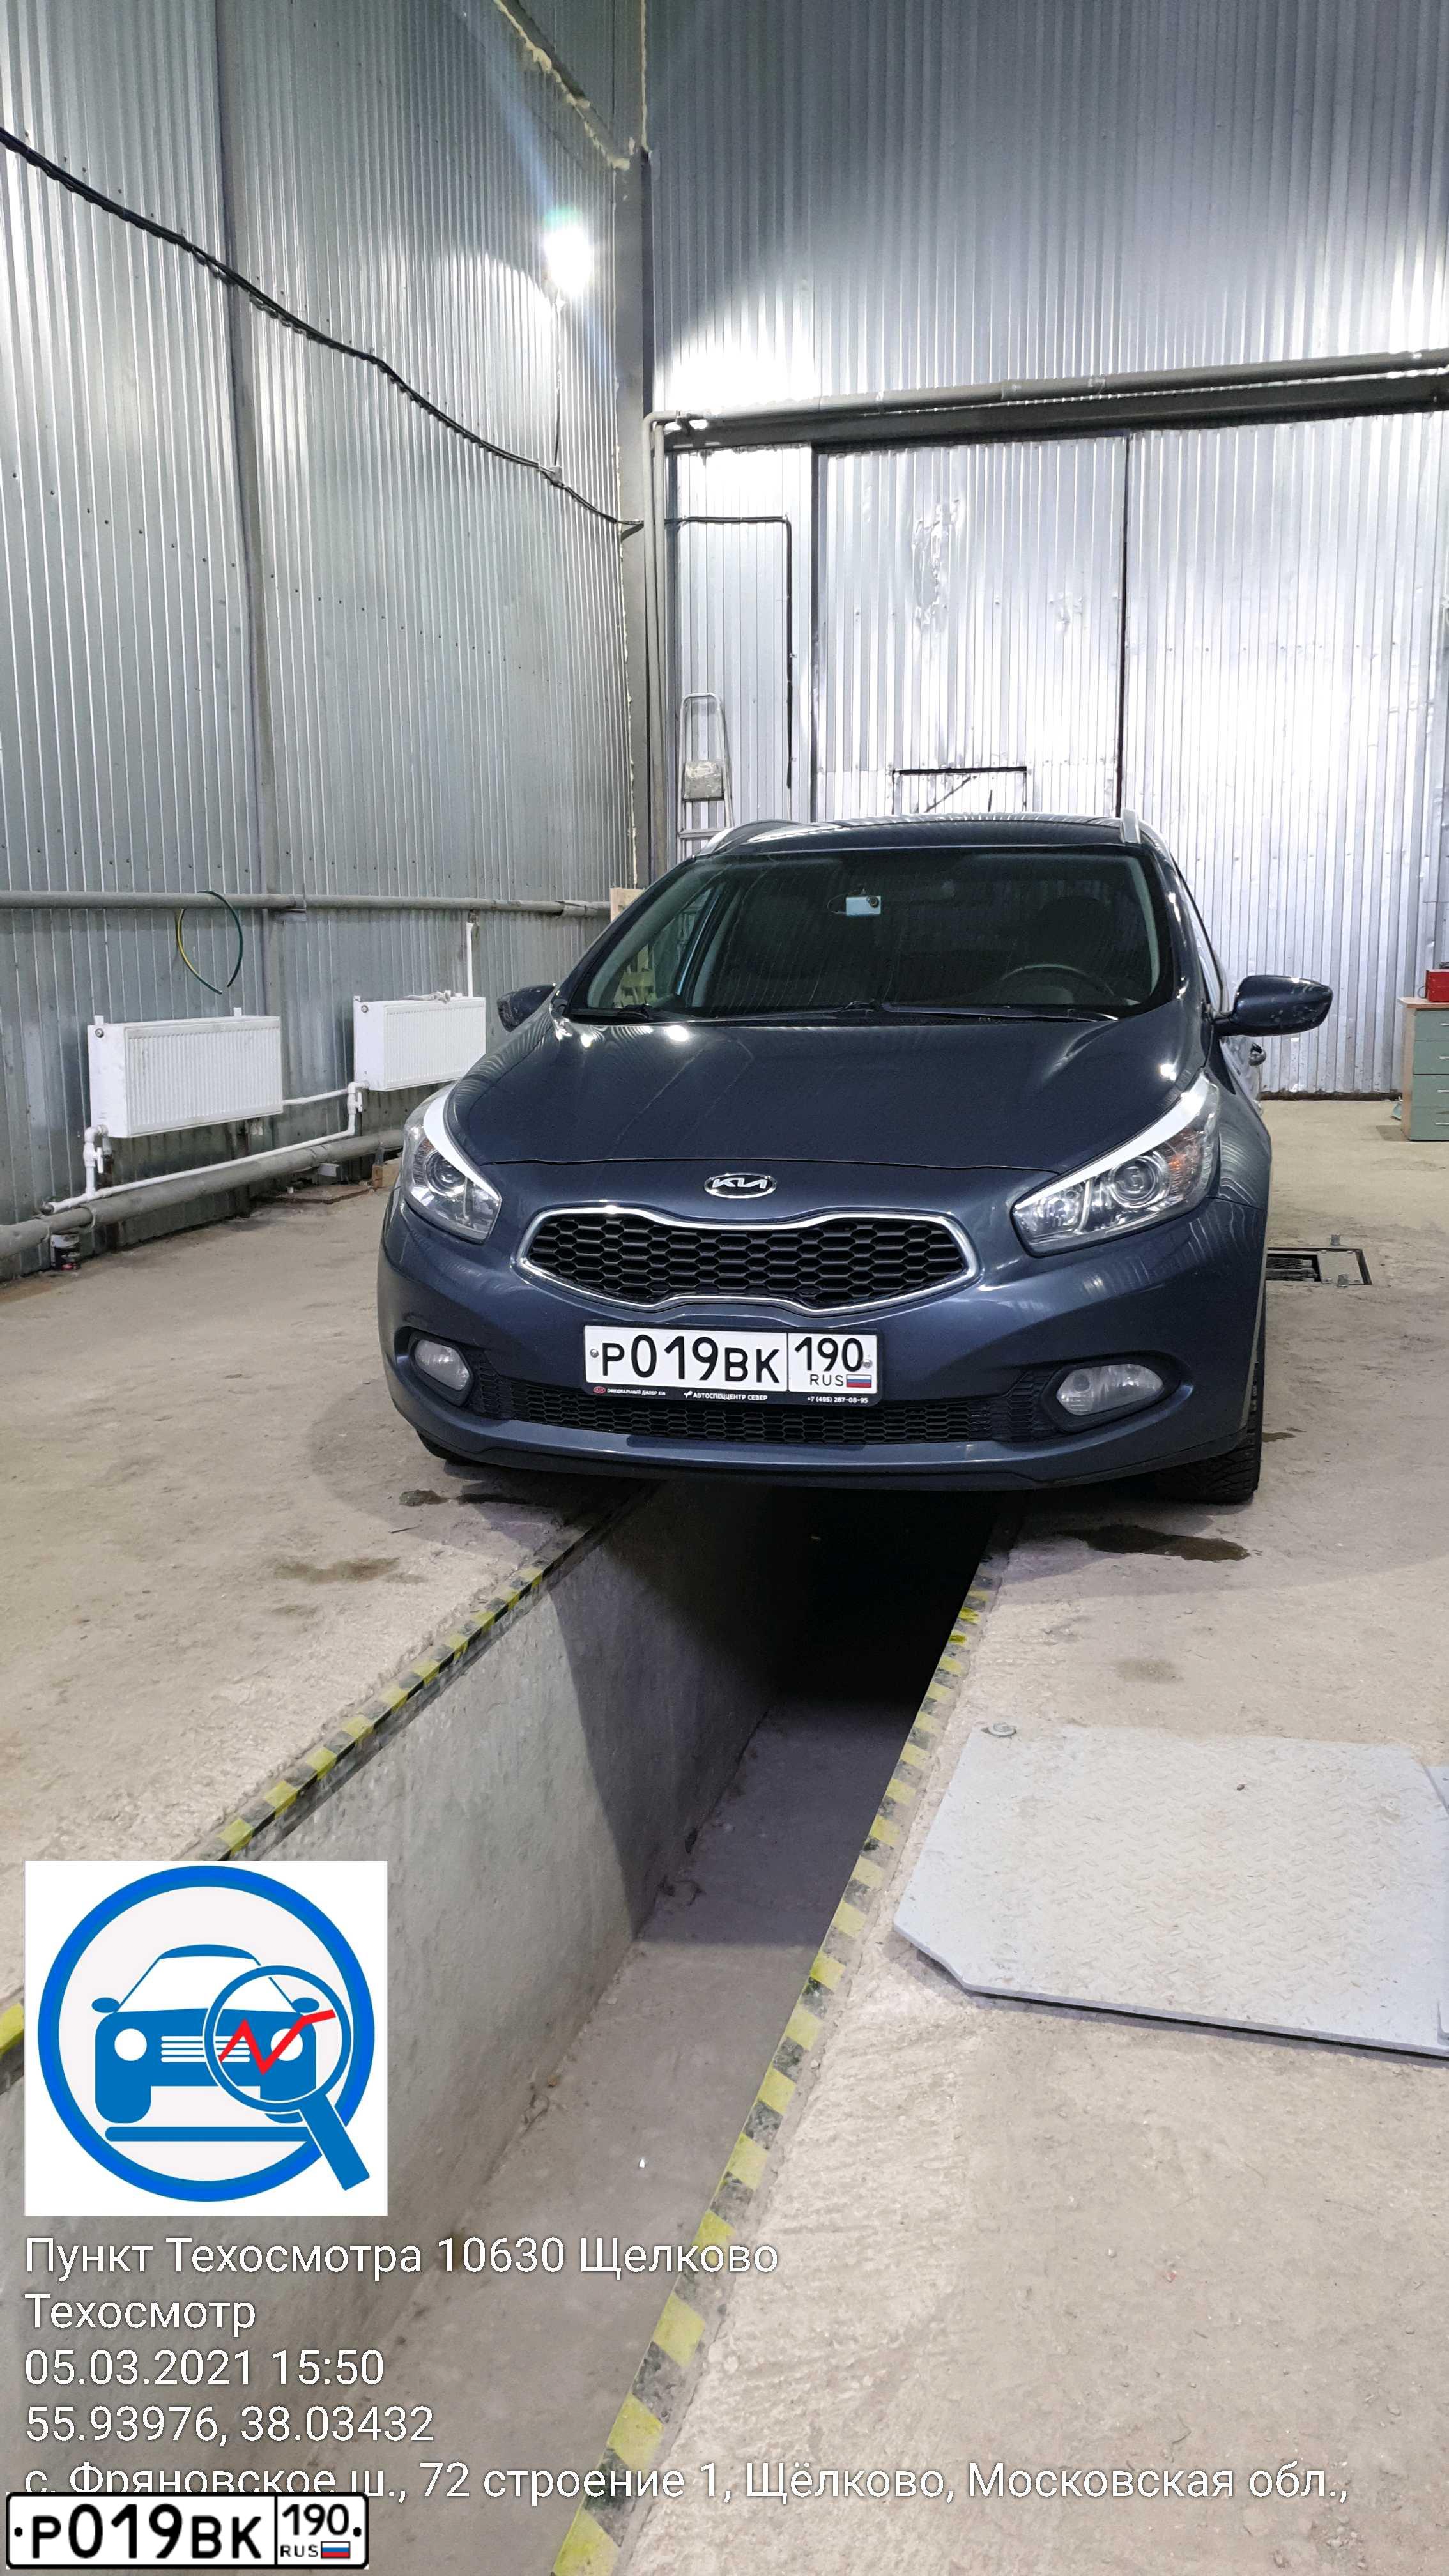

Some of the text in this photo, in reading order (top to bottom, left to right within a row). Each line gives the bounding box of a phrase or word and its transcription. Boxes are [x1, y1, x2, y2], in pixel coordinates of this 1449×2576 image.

[712, 1177, 767, 1189] KIA
[602, 1334, 863, 1383] Р019ВК 190
[809, 1374, 844, 1386] RUS
[693, 1392, 746, 1400] АВТОСПЕЦЦЕНТР
